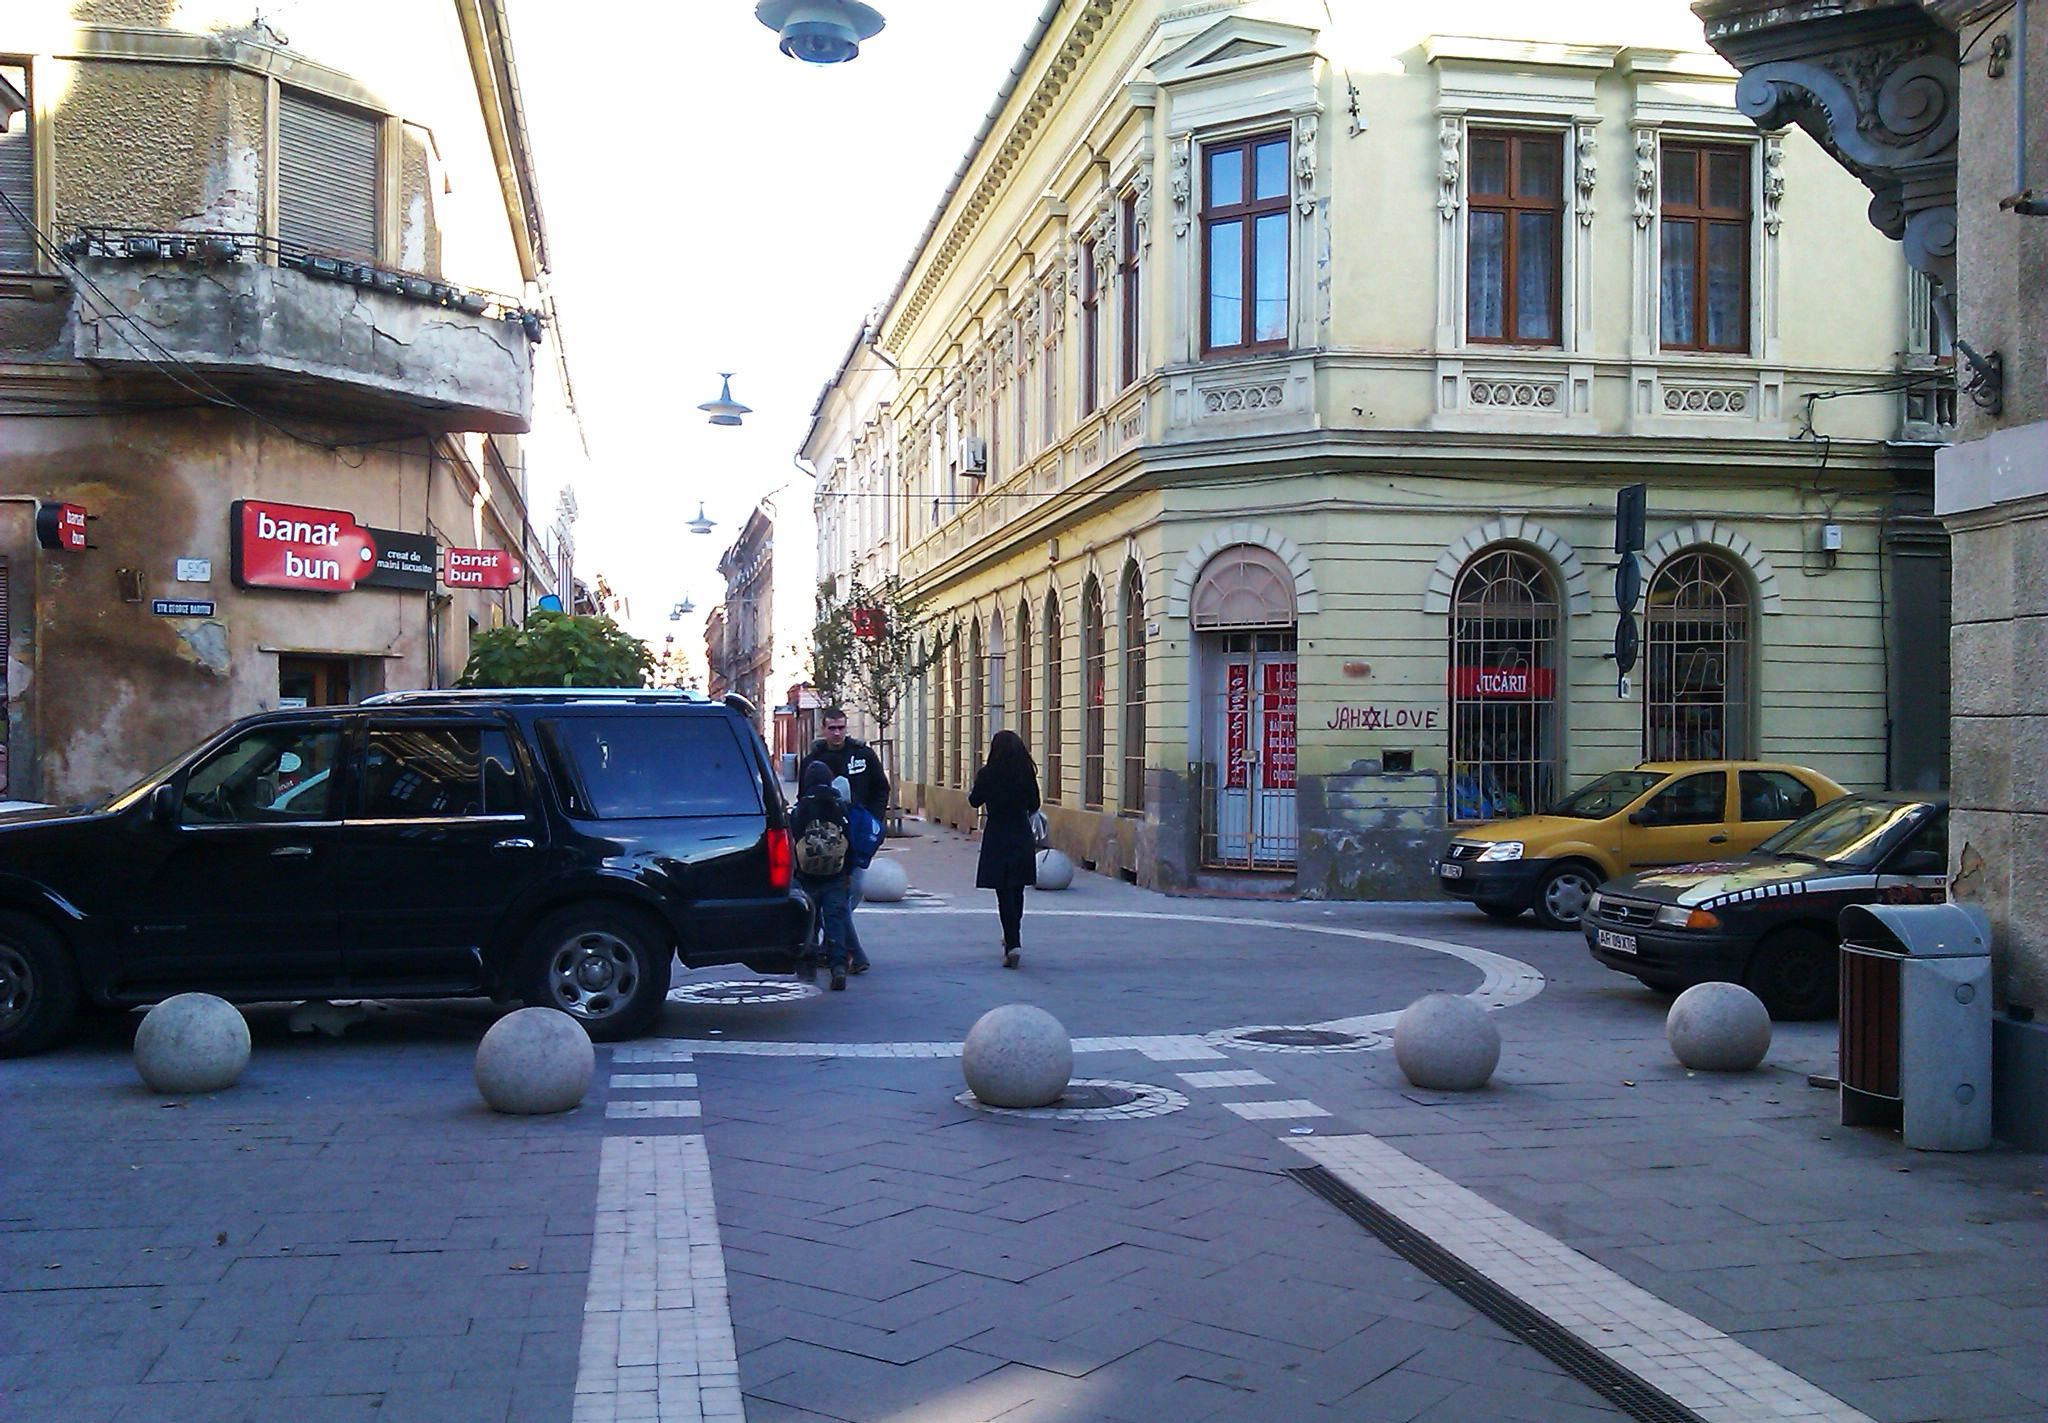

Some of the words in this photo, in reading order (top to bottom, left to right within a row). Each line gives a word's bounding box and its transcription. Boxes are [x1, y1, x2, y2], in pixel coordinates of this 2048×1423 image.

[66, 509, 85, 527] banat
[72, 529, 85, 545] bun
[258, 512, 340, 547] banat
[387, 550, 409, 561] creat
[410, 550, 421, 562] de
[450, 552, 499, 567] banat
[285, 551, 340, 581] bun
[401, 561, 433, 574] iscusite
[450, 569, 483, 582] bun
[1476, 671, 1527, 693] JUCĂRII
[1327, 706, 1361, 730] JAH
[1383, 710, 1440, 728] LOVE
[1600, 930, 1611, 945] AR
